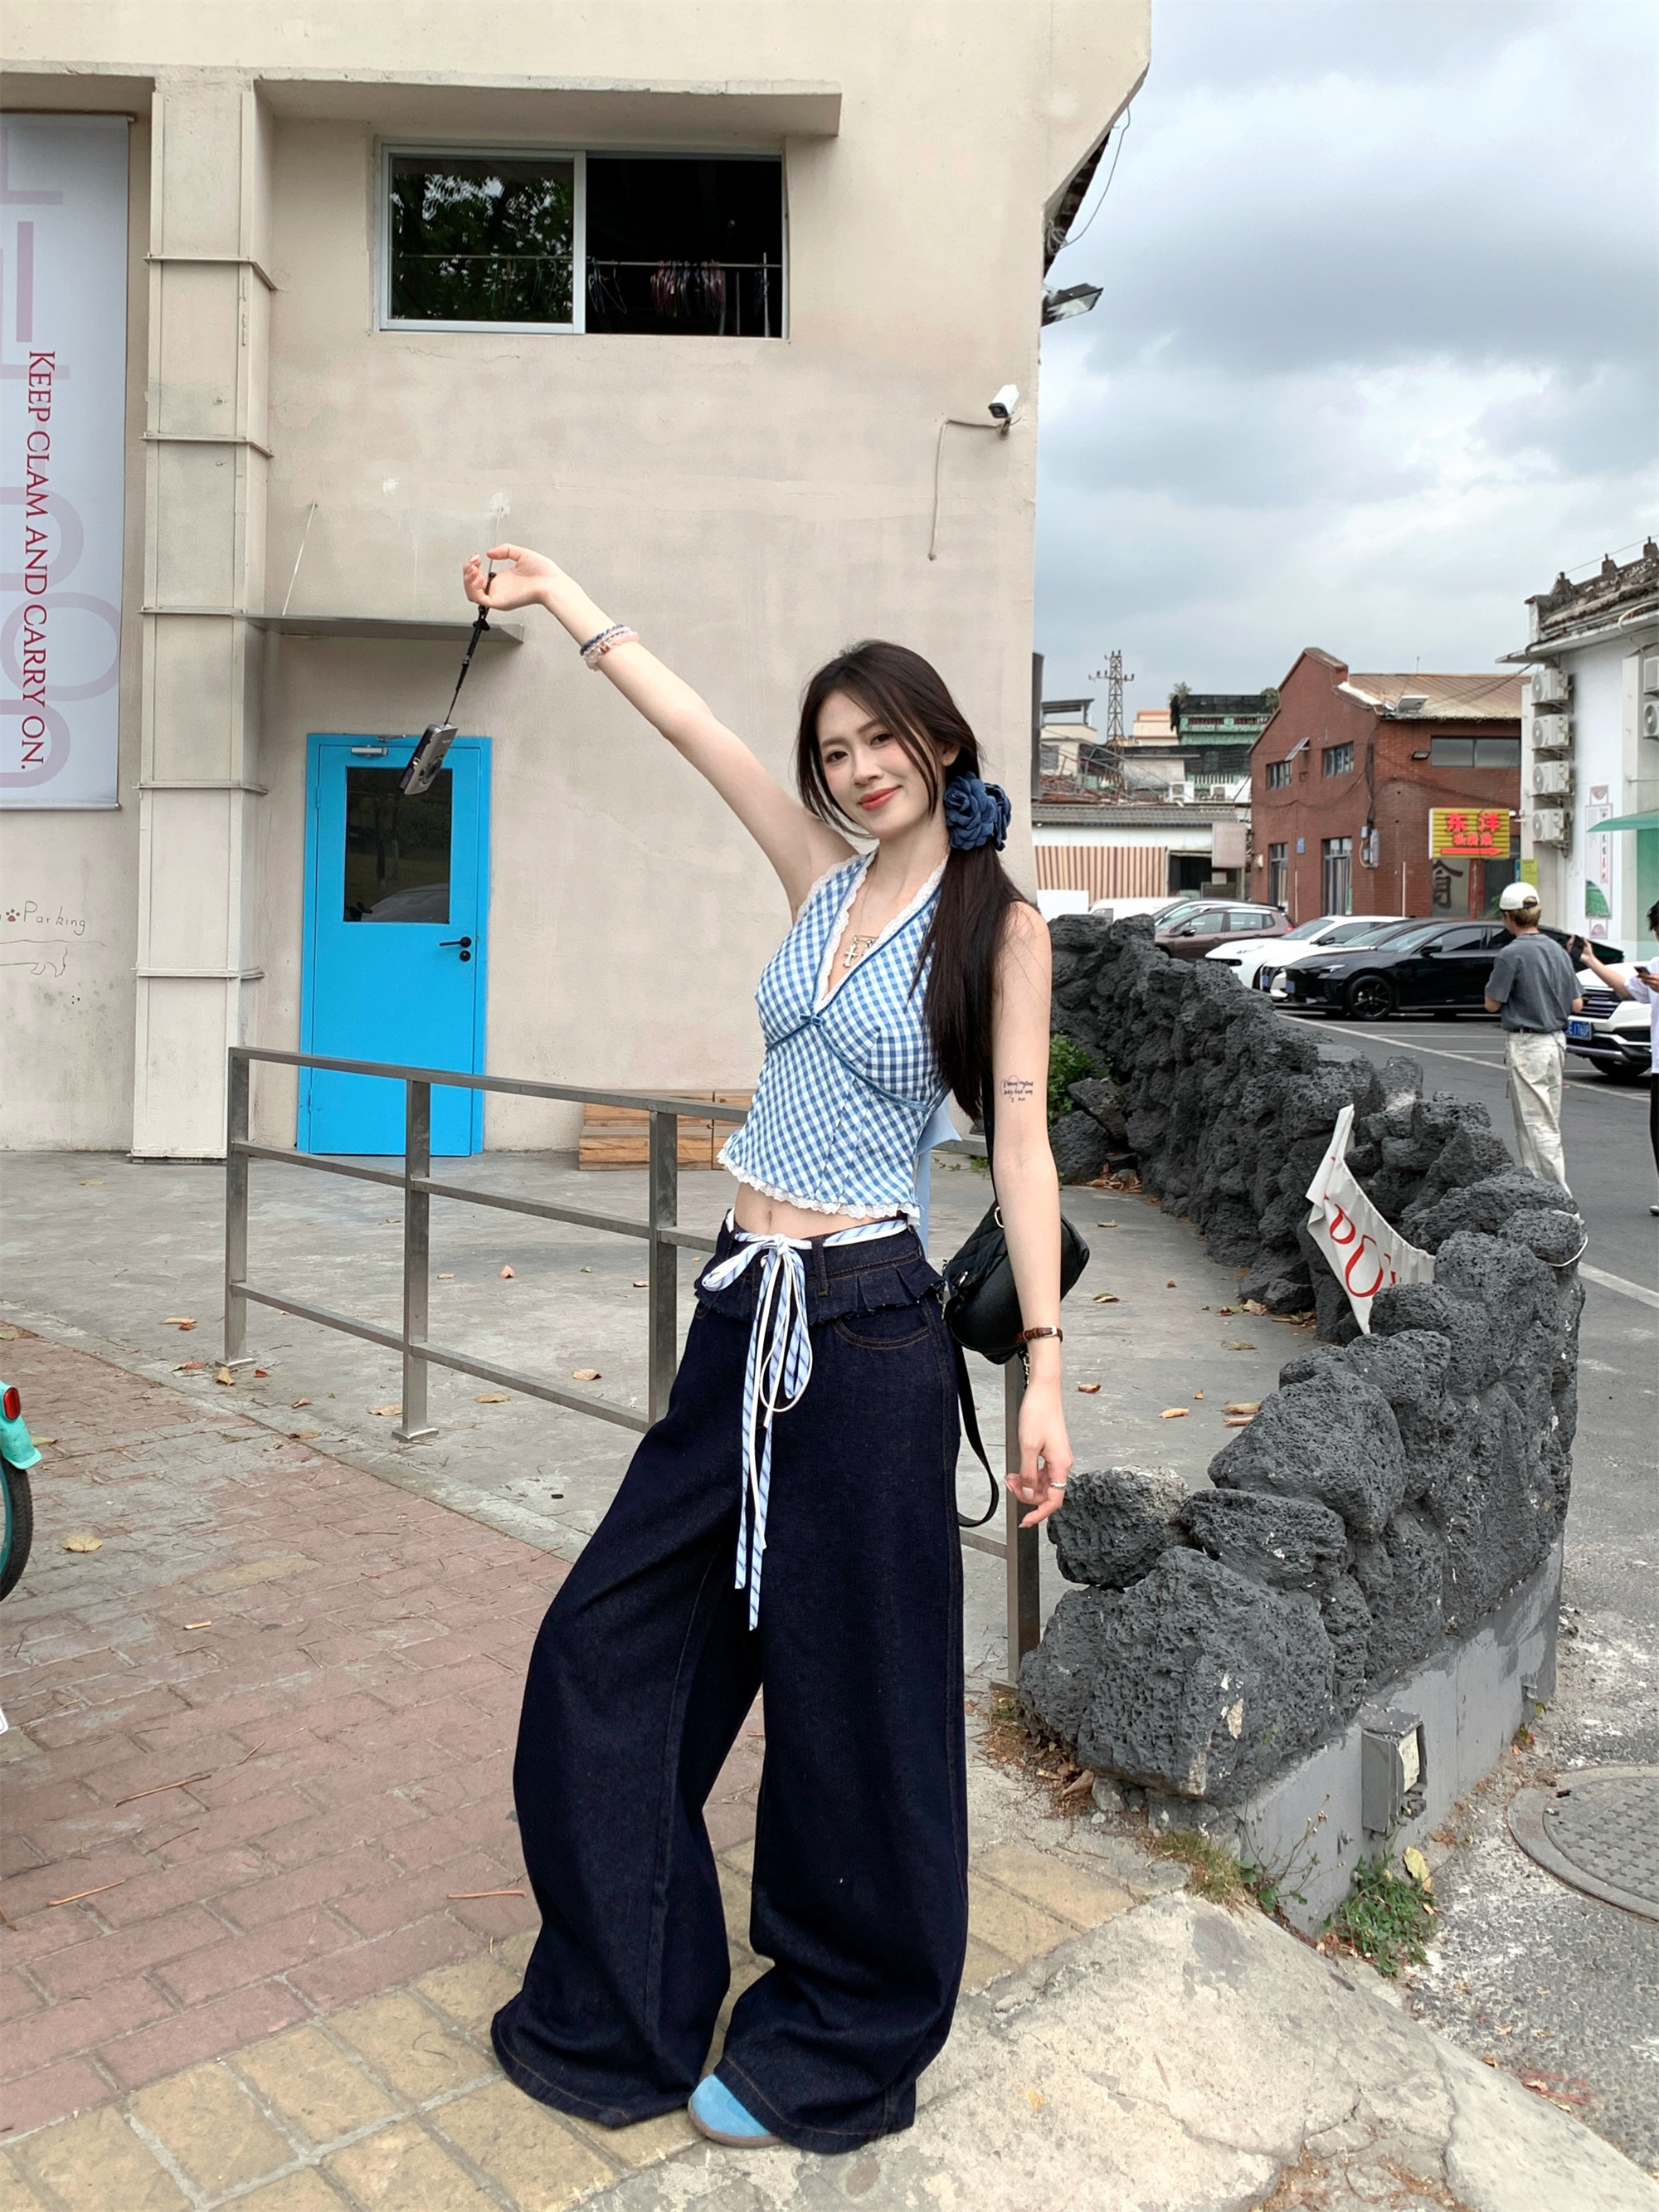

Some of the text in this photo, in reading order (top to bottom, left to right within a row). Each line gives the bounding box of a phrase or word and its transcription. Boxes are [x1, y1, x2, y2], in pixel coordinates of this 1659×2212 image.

[21, 350, 56, 769] KEEP CLAM AND CARRY ON.
[1446, 812, 1501, 833] 东洋
[23, 900, 86, 936] Parking
